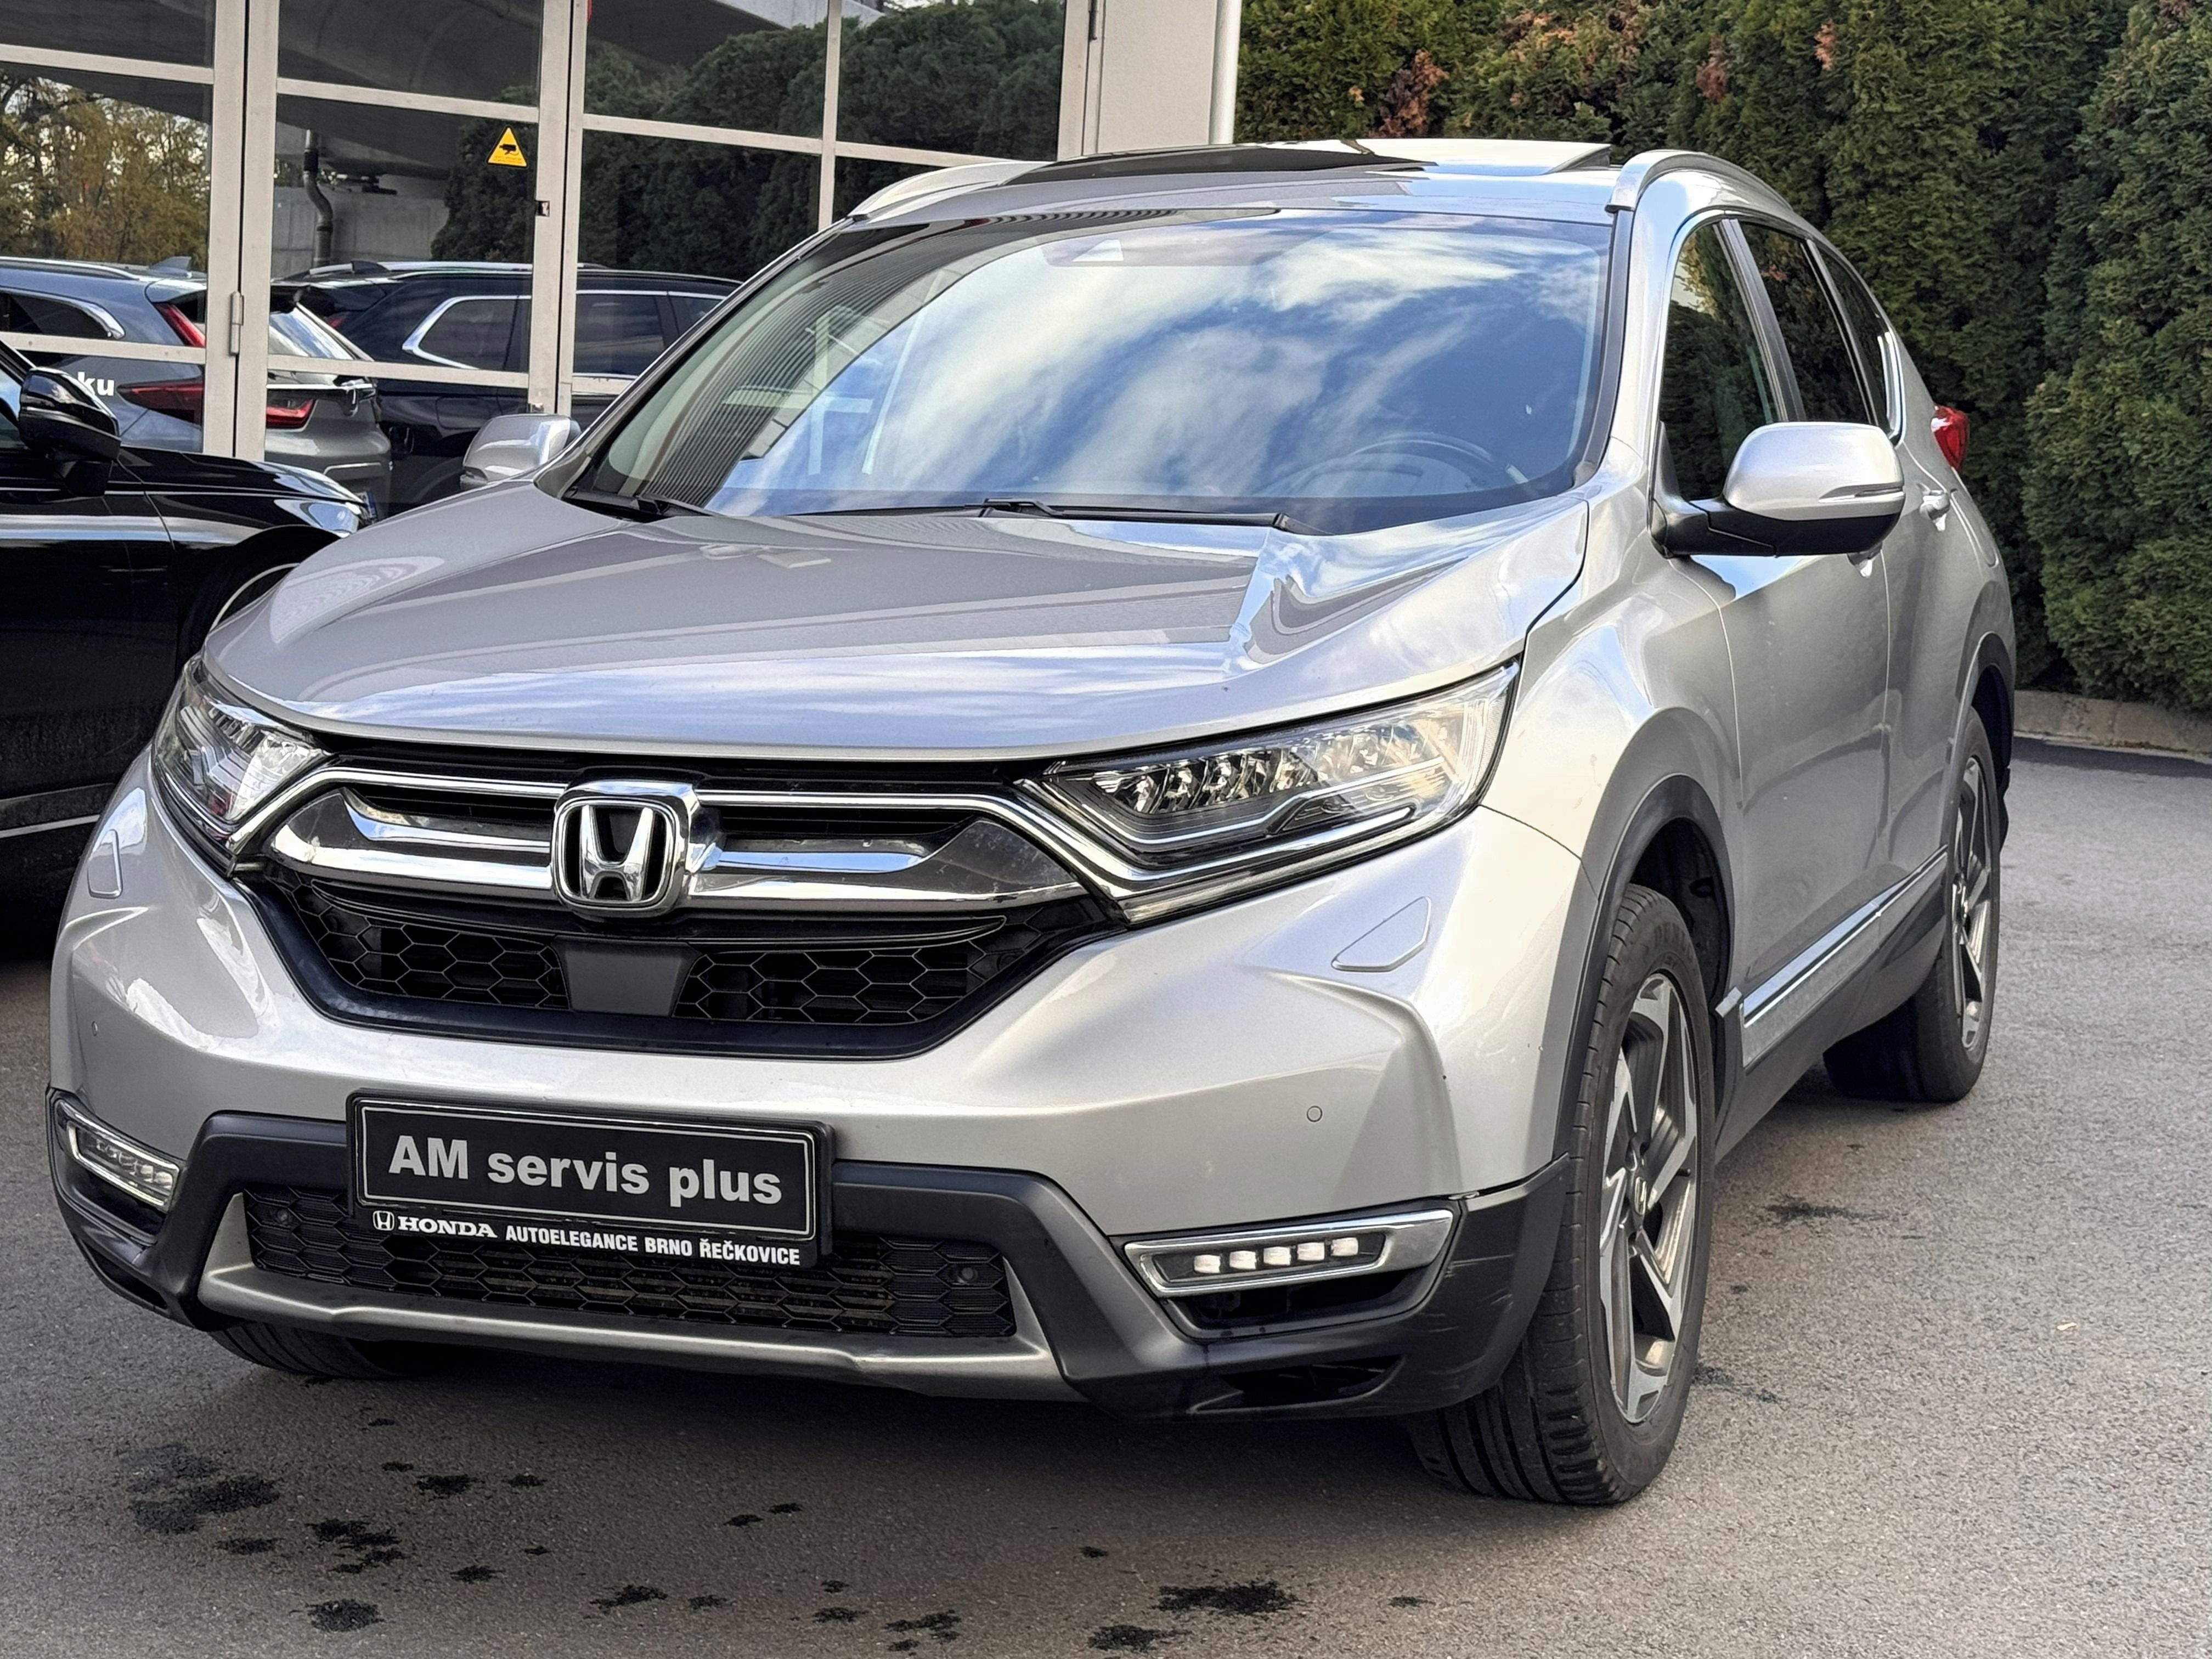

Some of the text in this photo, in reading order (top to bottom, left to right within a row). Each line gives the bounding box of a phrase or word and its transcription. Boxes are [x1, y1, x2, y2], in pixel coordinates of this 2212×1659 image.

[388, 1135, 782, 1207] AM servis plus
[397, 1216, 498, 1238] HONDA
[505, 1225, 639, 1251] AUTOELEGANCE
[645, 1237, 692, 1256] BRNO
[699, 1238, 800, 1266] ŘEČKOVICE
